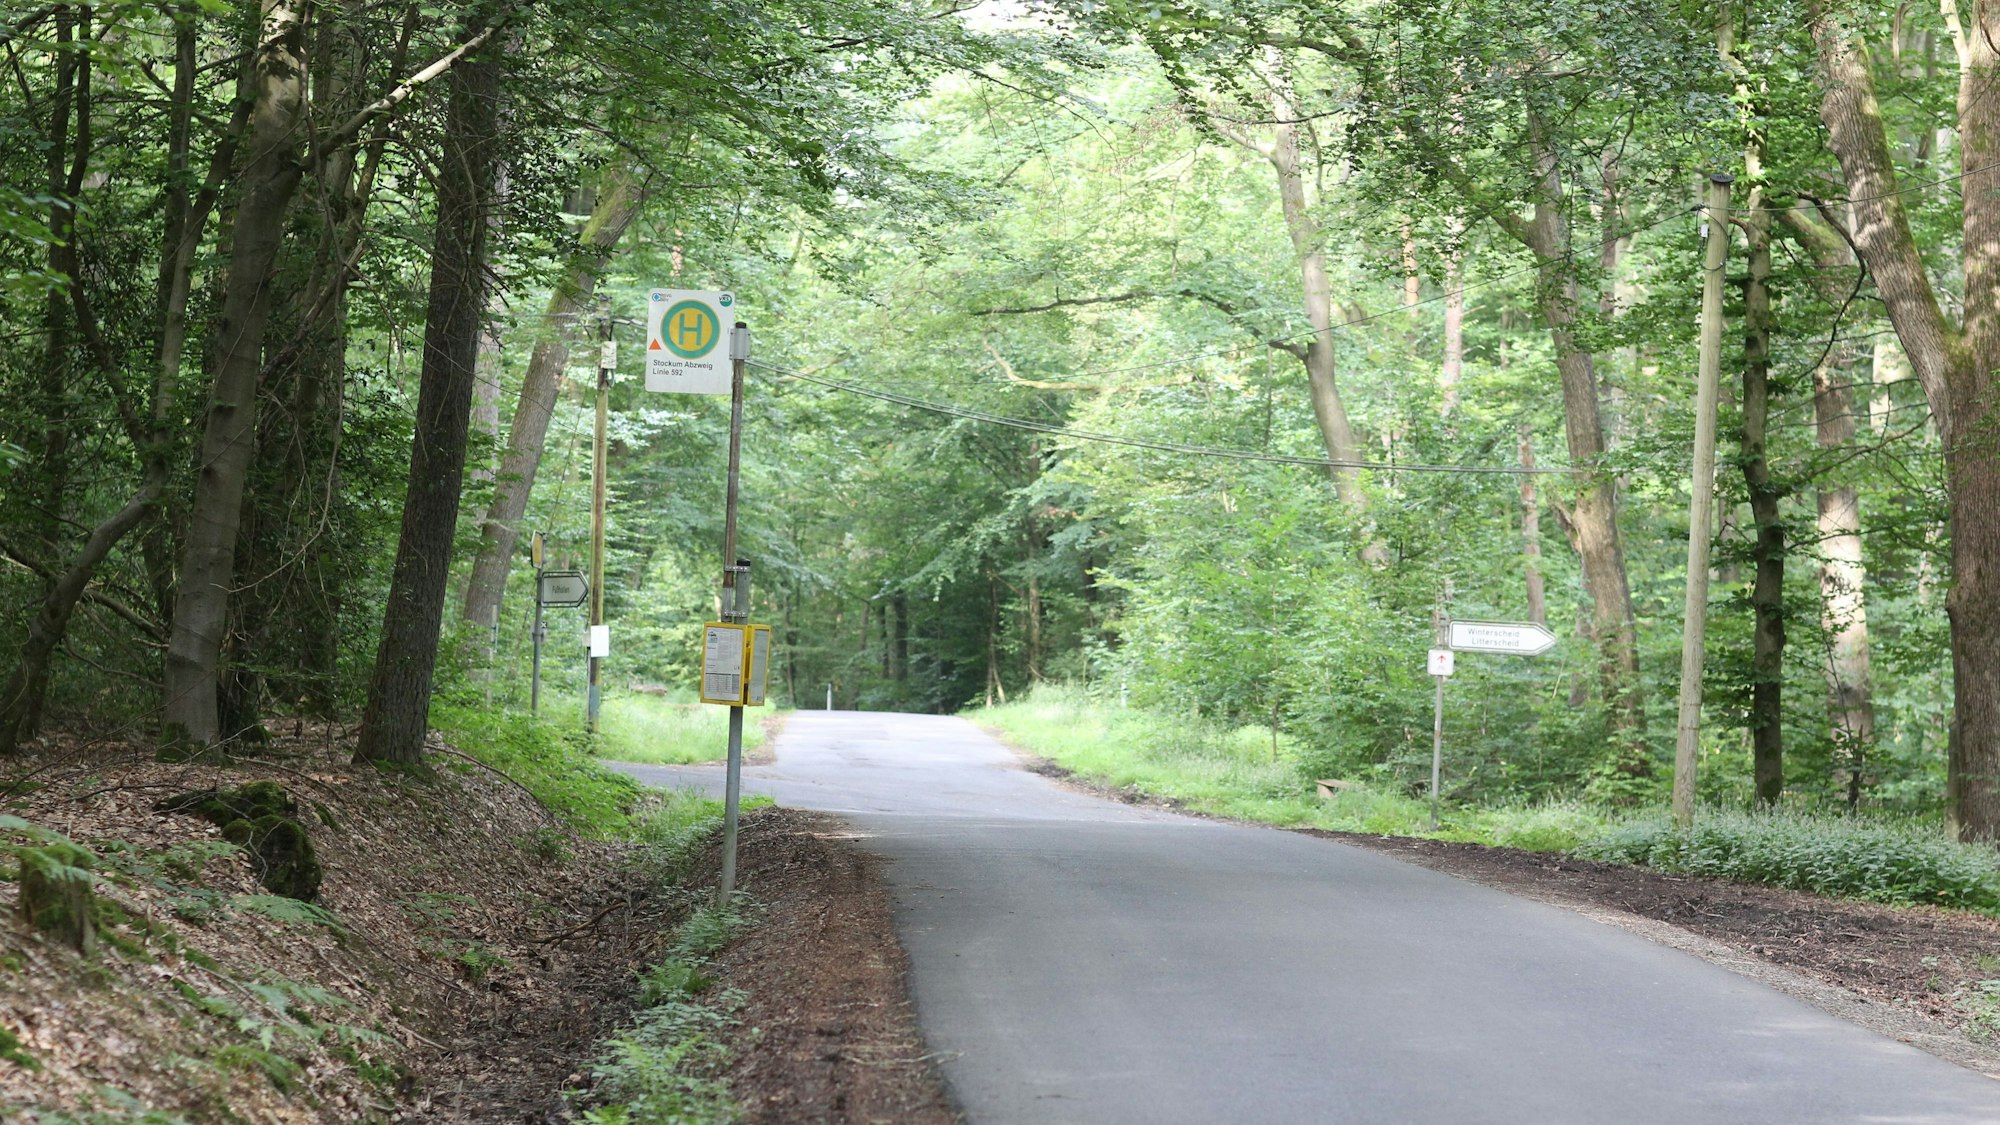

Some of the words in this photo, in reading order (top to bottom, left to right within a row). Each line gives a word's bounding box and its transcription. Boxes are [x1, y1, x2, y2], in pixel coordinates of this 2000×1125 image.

[679, 313, 702, 345] H
[684, 362, 713, 370] Abzweig
[1468, 628, 1520, 637] Winterscheid
[1472, 637, 1519, 646] Litterscheid
